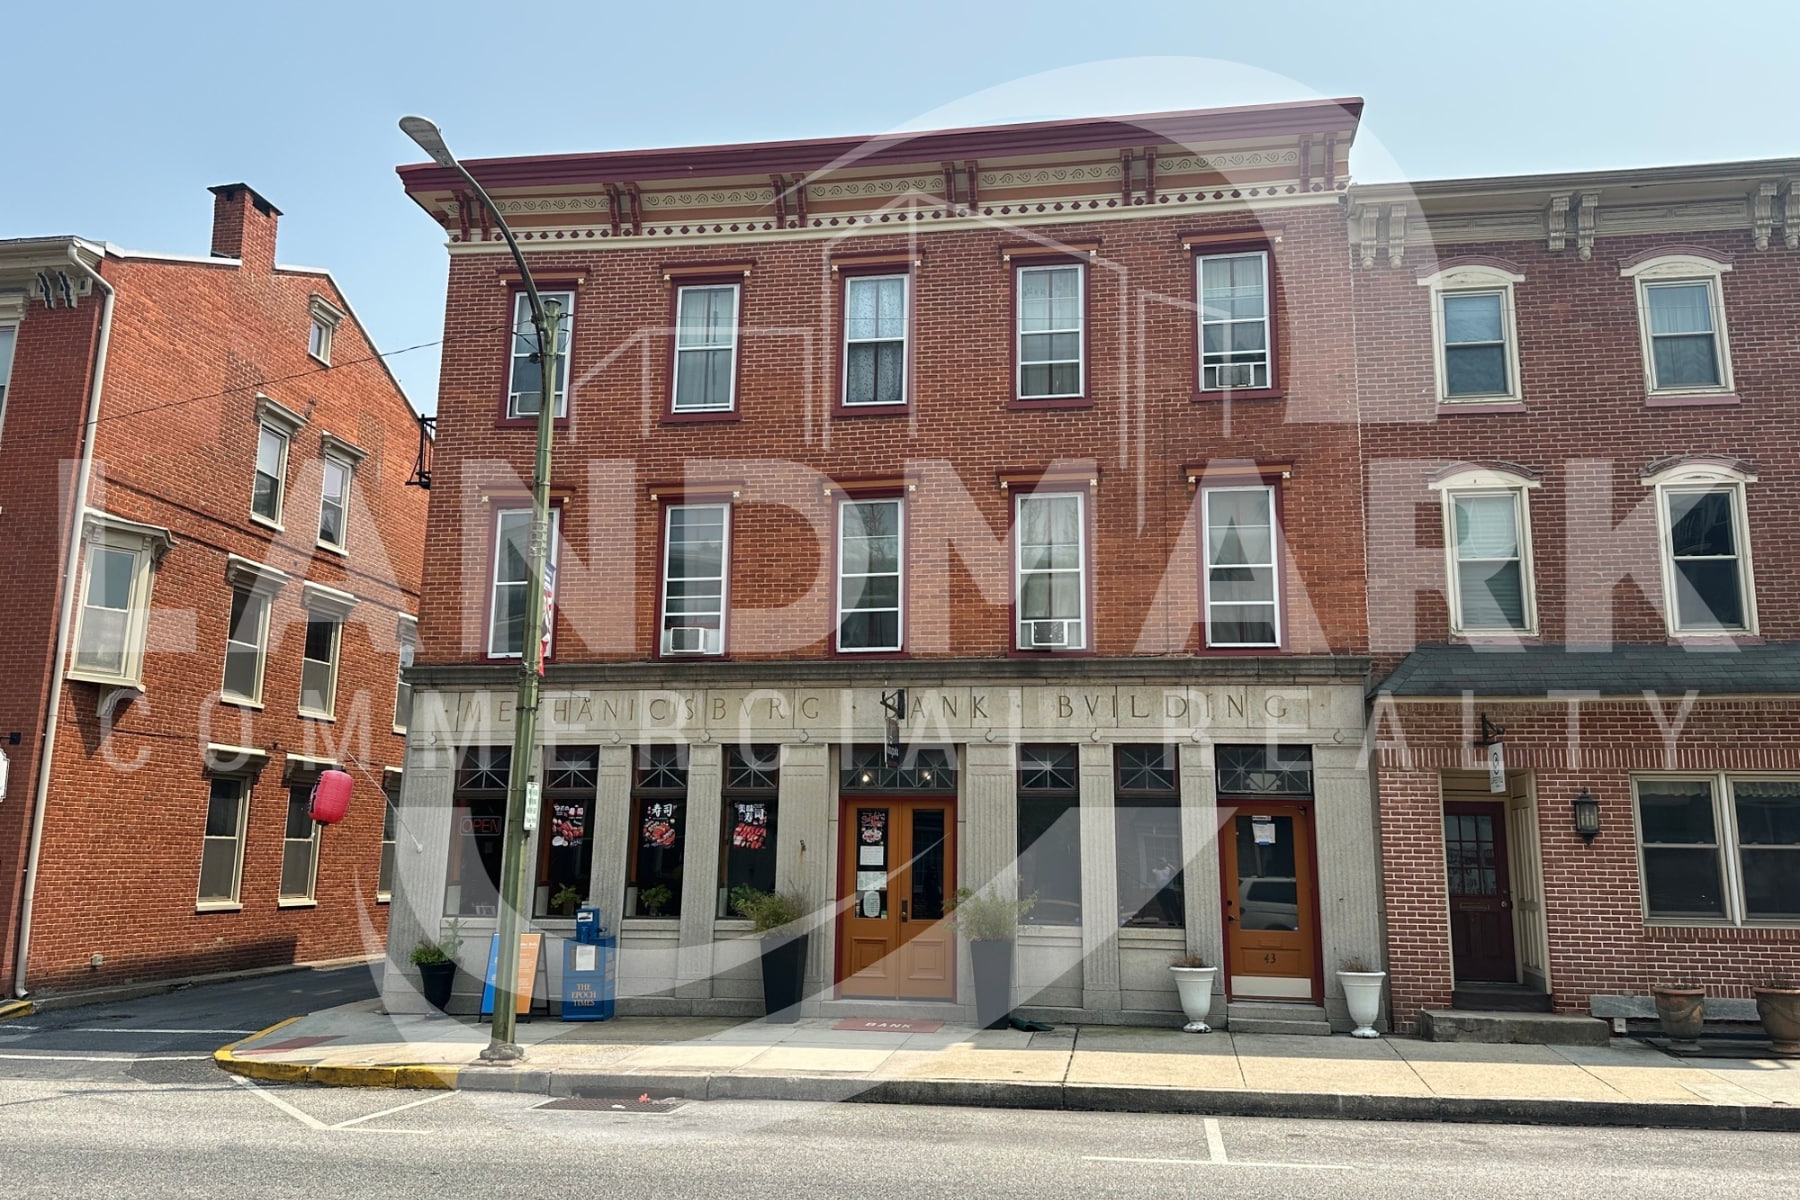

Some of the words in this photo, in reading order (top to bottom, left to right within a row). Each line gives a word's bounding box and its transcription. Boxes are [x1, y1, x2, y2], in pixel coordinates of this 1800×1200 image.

[462, 697, 820, 722] MEHANICSBVRG
[1058, 694, 1288, 719] BVILDING
[462, 818, 499, 833] OPEN
[1264, 952, 1276, 965] 43
[576, 983, 591, 991] THE
[571, 991, 597, 1000] EPOCH
[863, 1022, 912, 1030] BANK
